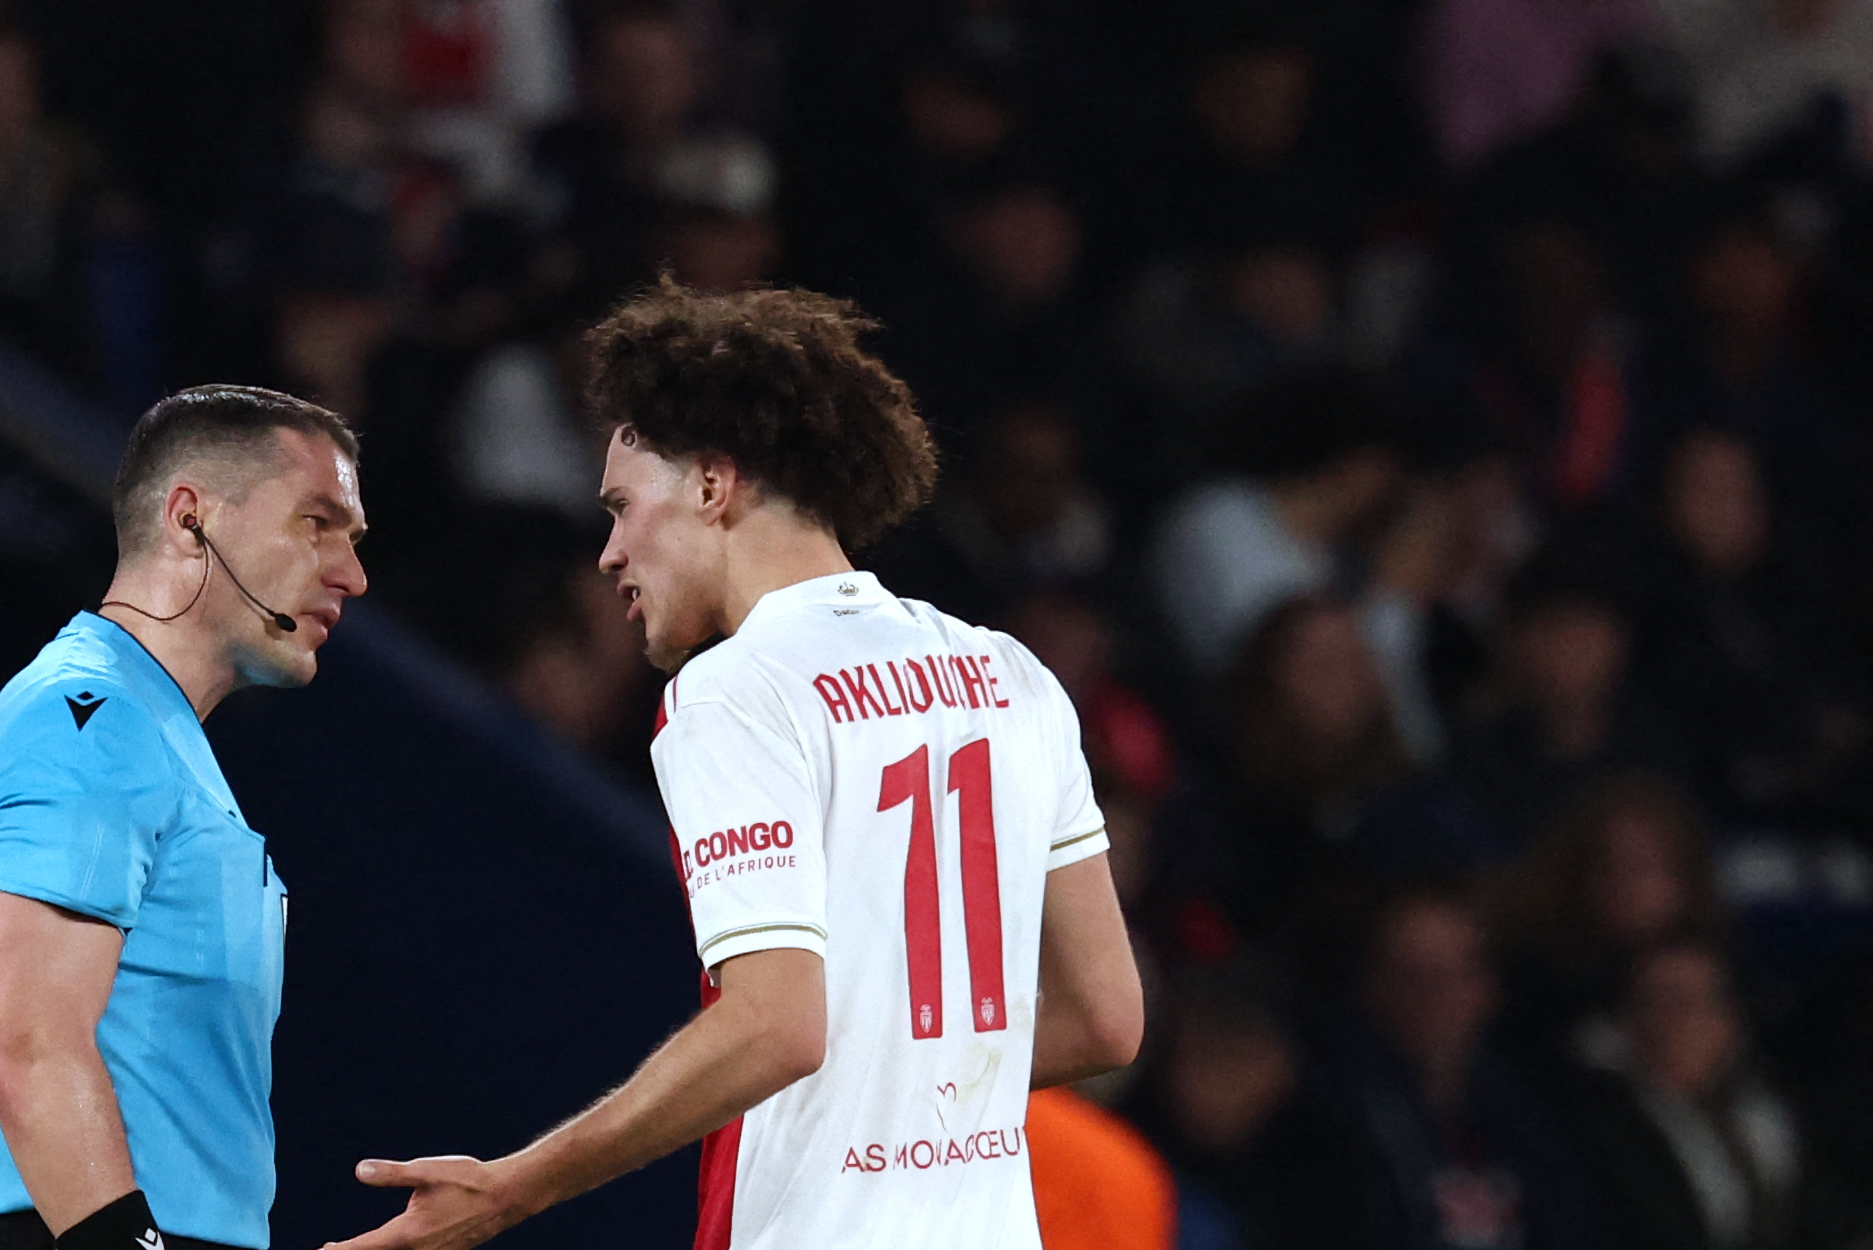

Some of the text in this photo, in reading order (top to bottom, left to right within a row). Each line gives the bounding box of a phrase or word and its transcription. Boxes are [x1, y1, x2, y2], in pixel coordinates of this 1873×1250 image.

[694, 820, 794, 868] CONGO
[715, 855, 797, 881] L'AFRIQUE
[876, 737, 1008, 1041] 11
[841, 1125, 1026, 1174] AS MONACŒU
